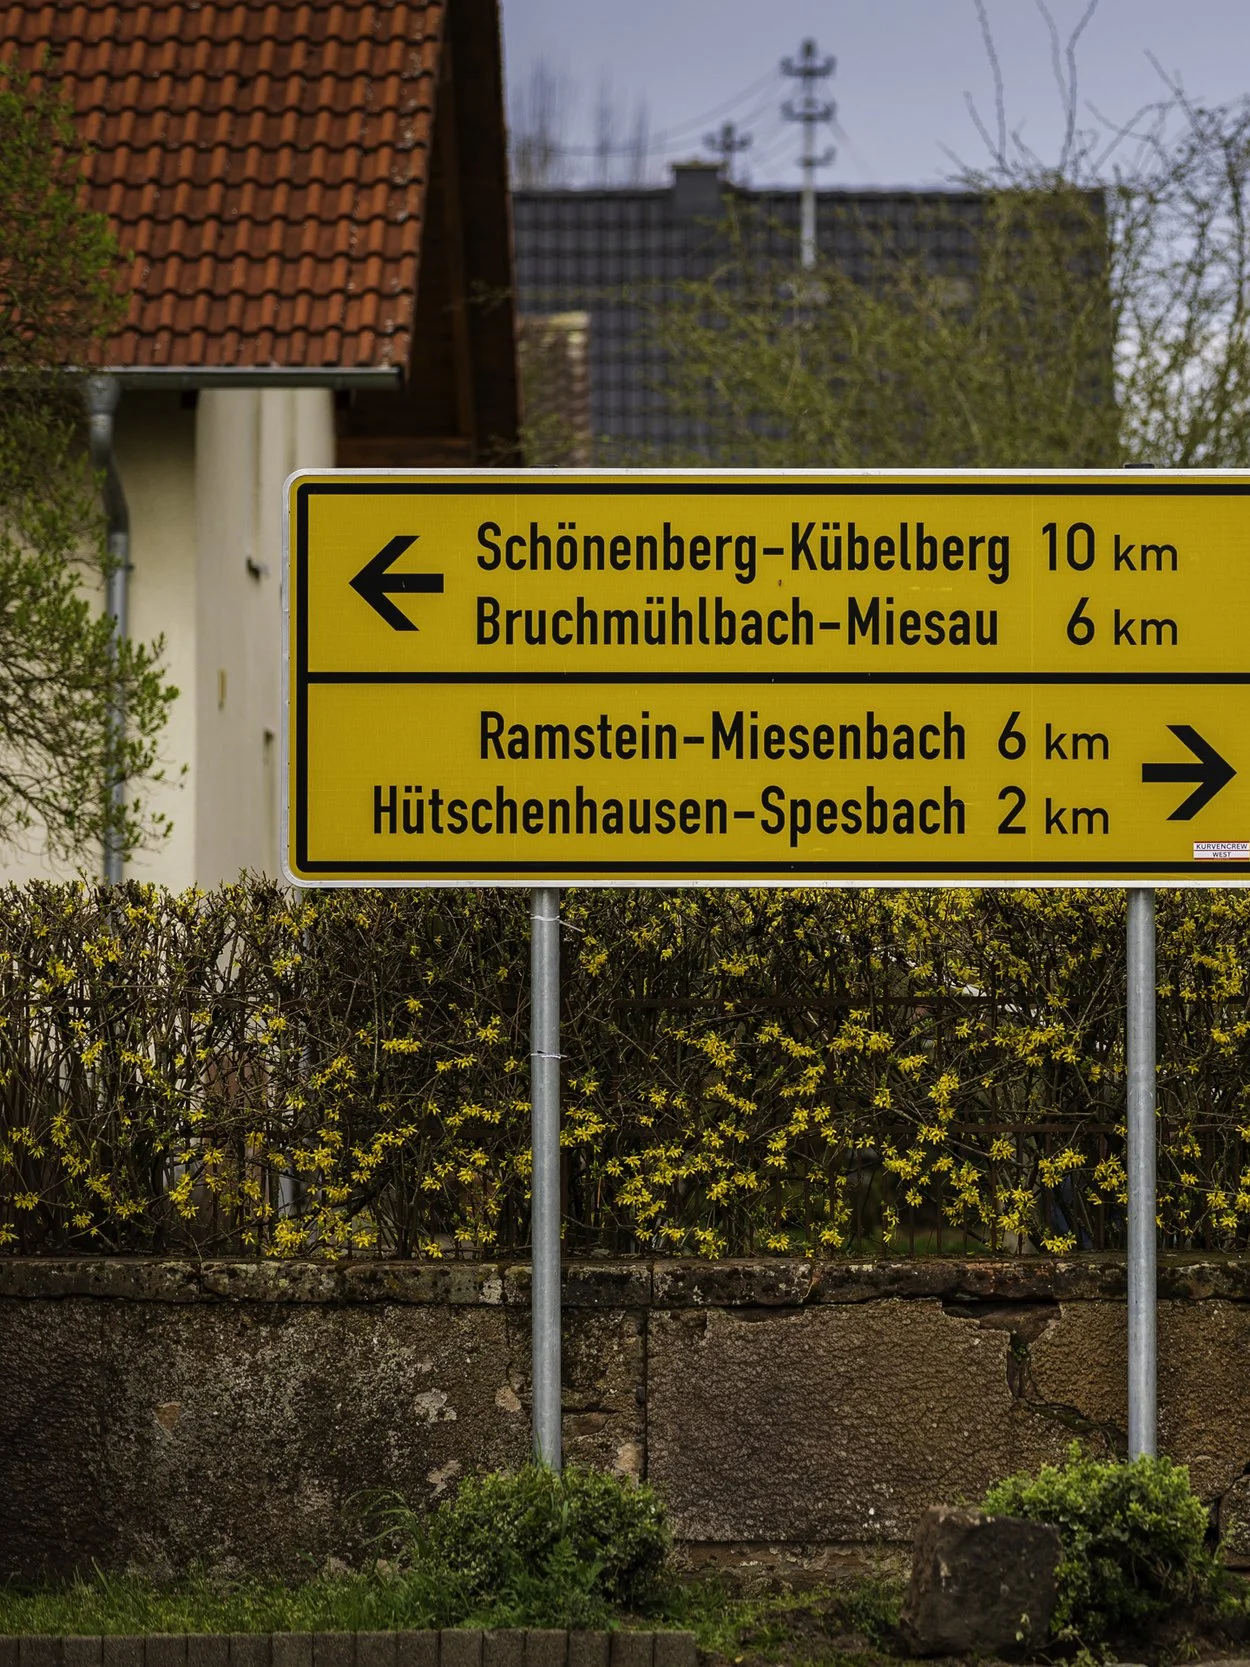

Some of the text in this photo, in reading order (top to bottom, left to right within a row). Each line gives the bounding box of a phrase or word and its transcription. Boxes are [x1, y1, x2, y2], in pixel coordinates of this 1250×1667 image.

[477, 521, 1178, 585] Schönenberg-Kübelberg 10 km
[476, 596, 1178, 646] Bruchmühlbach-Miesau 6 km
[480, 711, 1109, 761] Ramstein-Miesenbach 6 km
[373, 785, 1109, 847] Hütschenhausen-Spesbach 2 km
